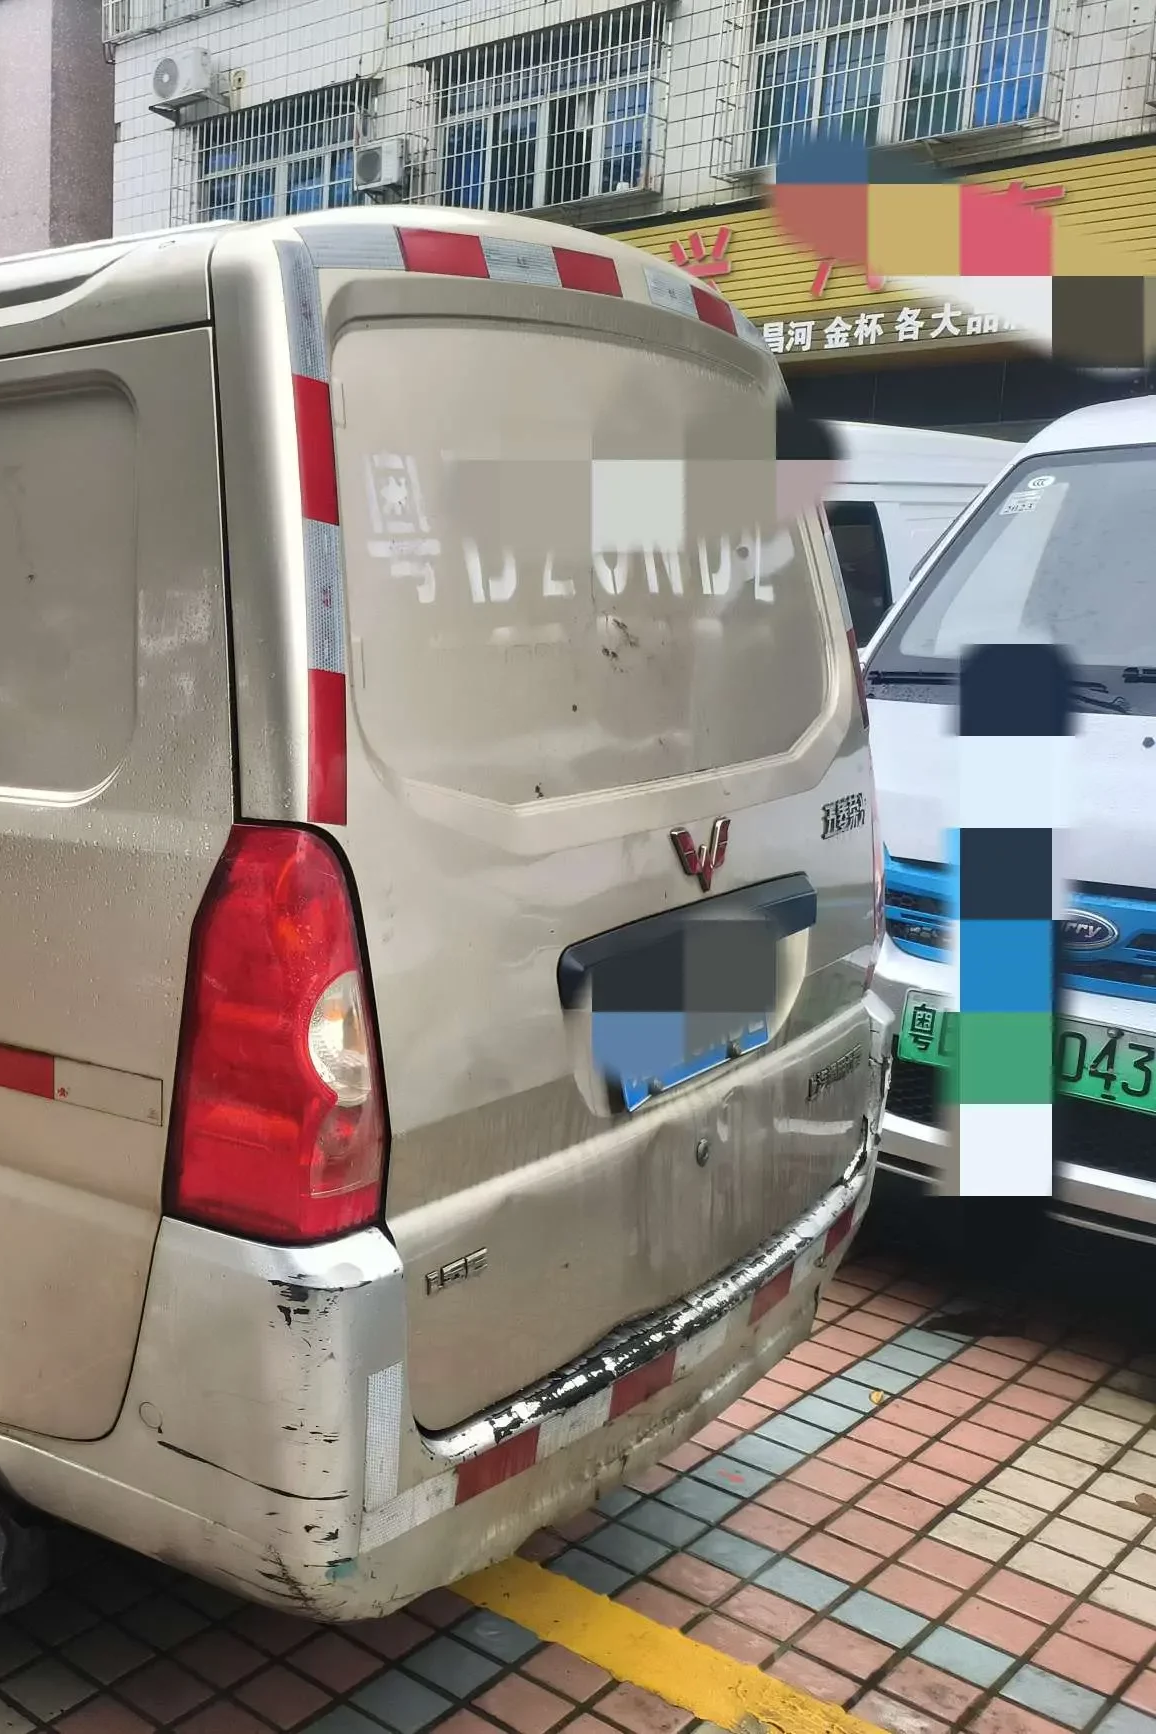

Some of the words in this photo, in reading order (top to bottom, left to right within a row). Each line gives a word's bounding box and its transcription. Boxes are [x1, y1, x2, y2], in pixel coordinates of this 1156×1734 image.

[763, 320, 815, 353] 昌河
[824, 312, 884, 349] 金杯
[895, 302, 1016, 342] 各大品
